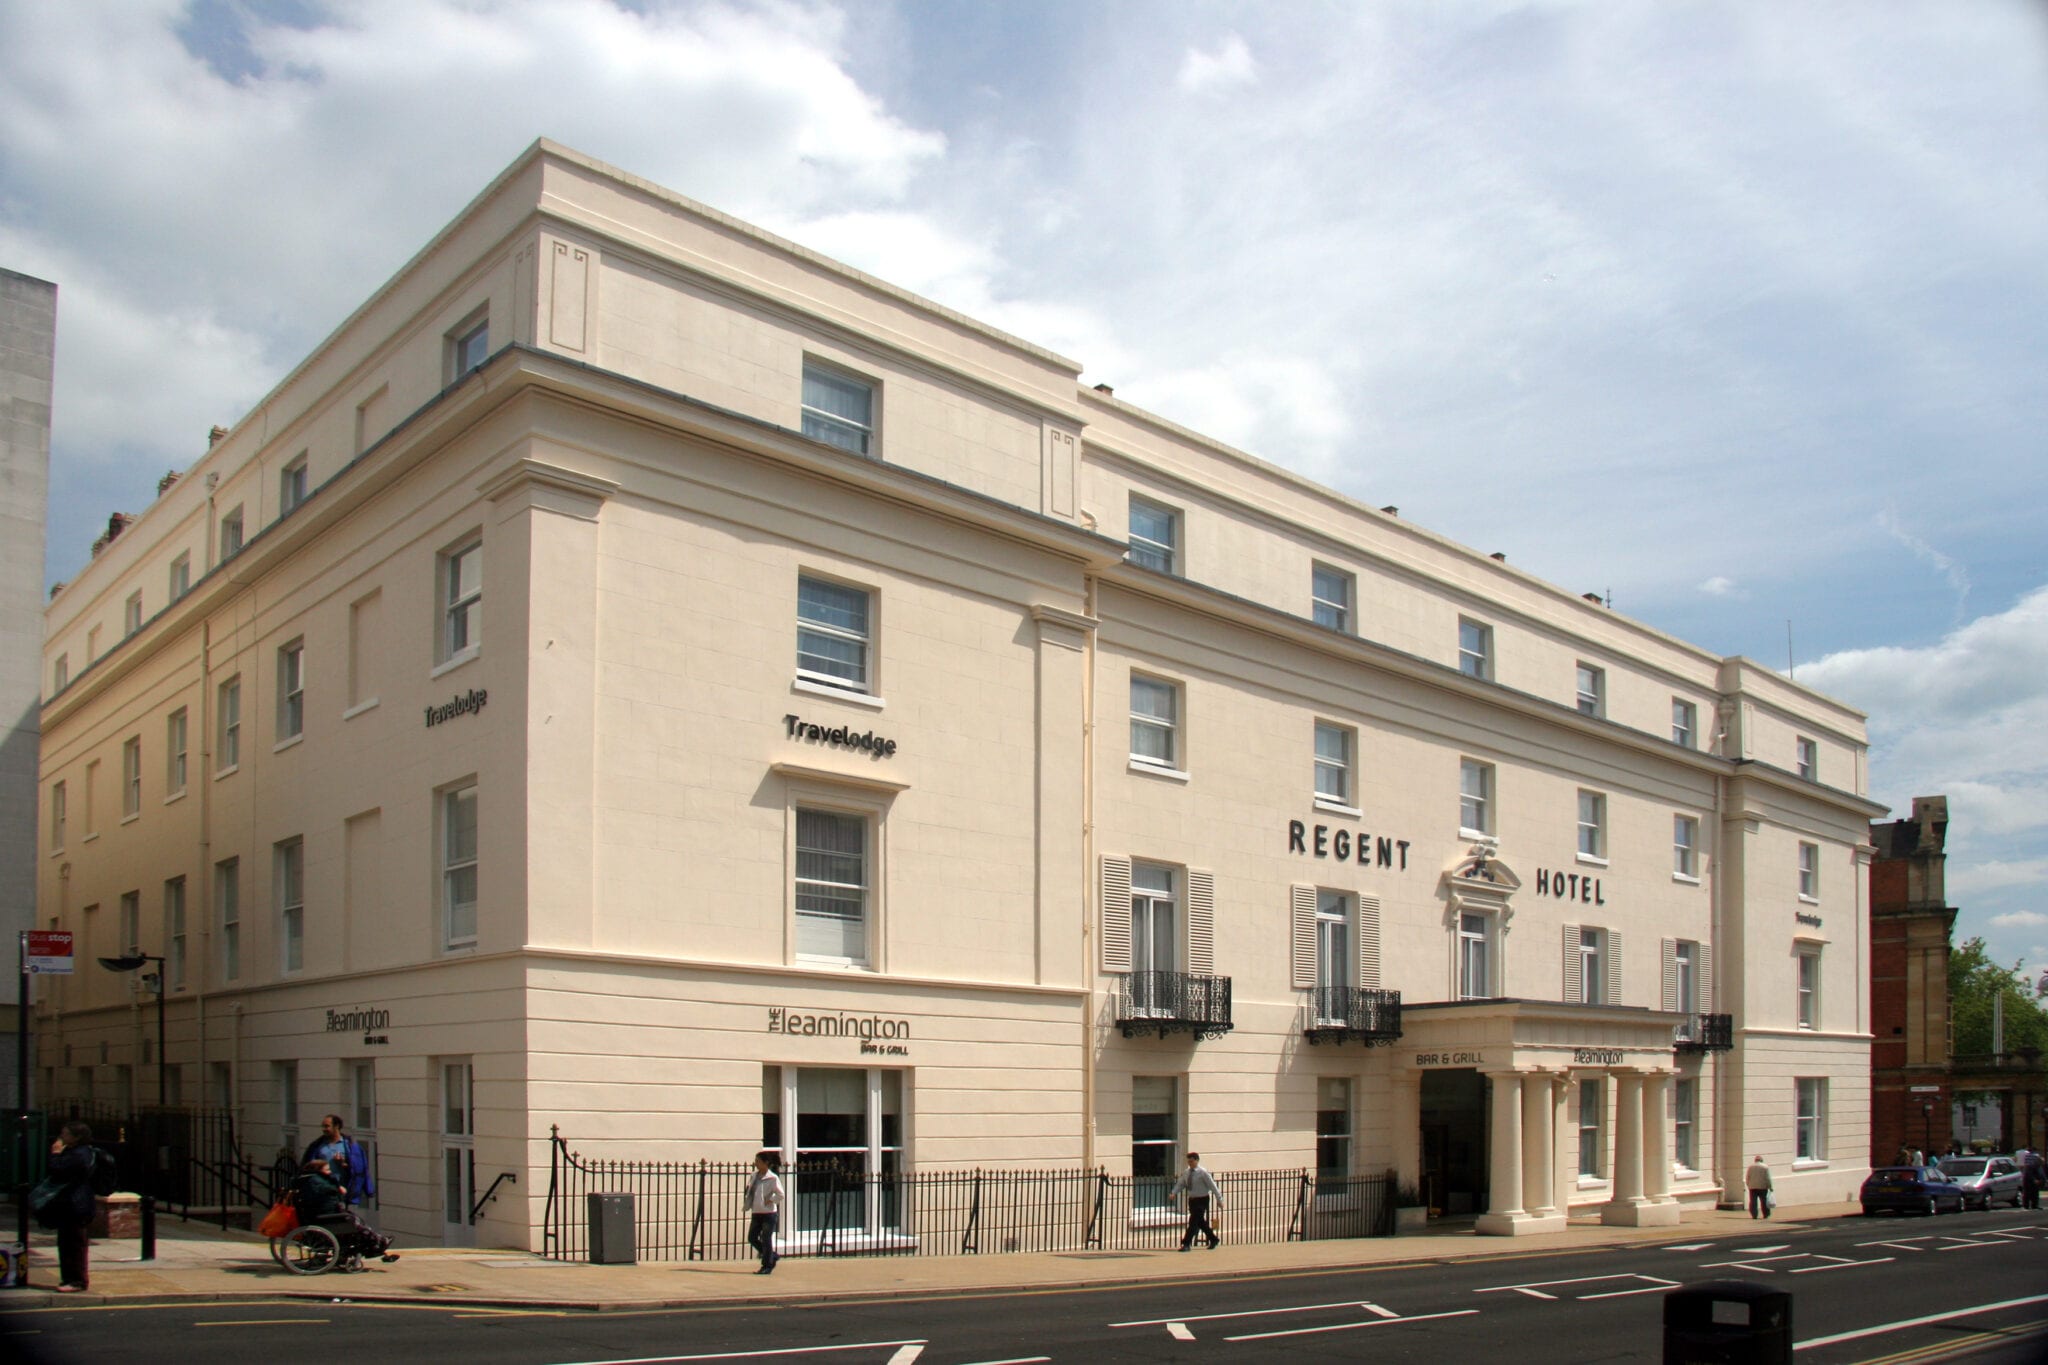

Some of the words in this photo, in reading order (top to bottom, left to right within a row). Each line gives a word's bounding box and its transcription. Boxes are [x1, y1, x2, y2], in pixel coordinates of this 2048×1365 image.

[424, 689, 488, 728] Travelodge
[785, 714, 897, 757] Travelodge
[1289, 819, 1410, 870] REGENT
[1536, 867, 1605, 905] HOTEL
[48, 935, 72, 944] stop
[333, 1006, 390, 1035] leamington
[769, 1008, 780, 1031] THE
[782, 1007, 909, 1043] leamington
[861, 1044, 877, 1055] BAR
[887, 1045, 908, 1056] GRILL
[1416, 1053, 1438, 1065] BAR
[1441, 1053, 1450, 1064] &
[1452, 1052, 1484, 1064] GRILL
[1579, 1049, 1623, 1065] leamington
